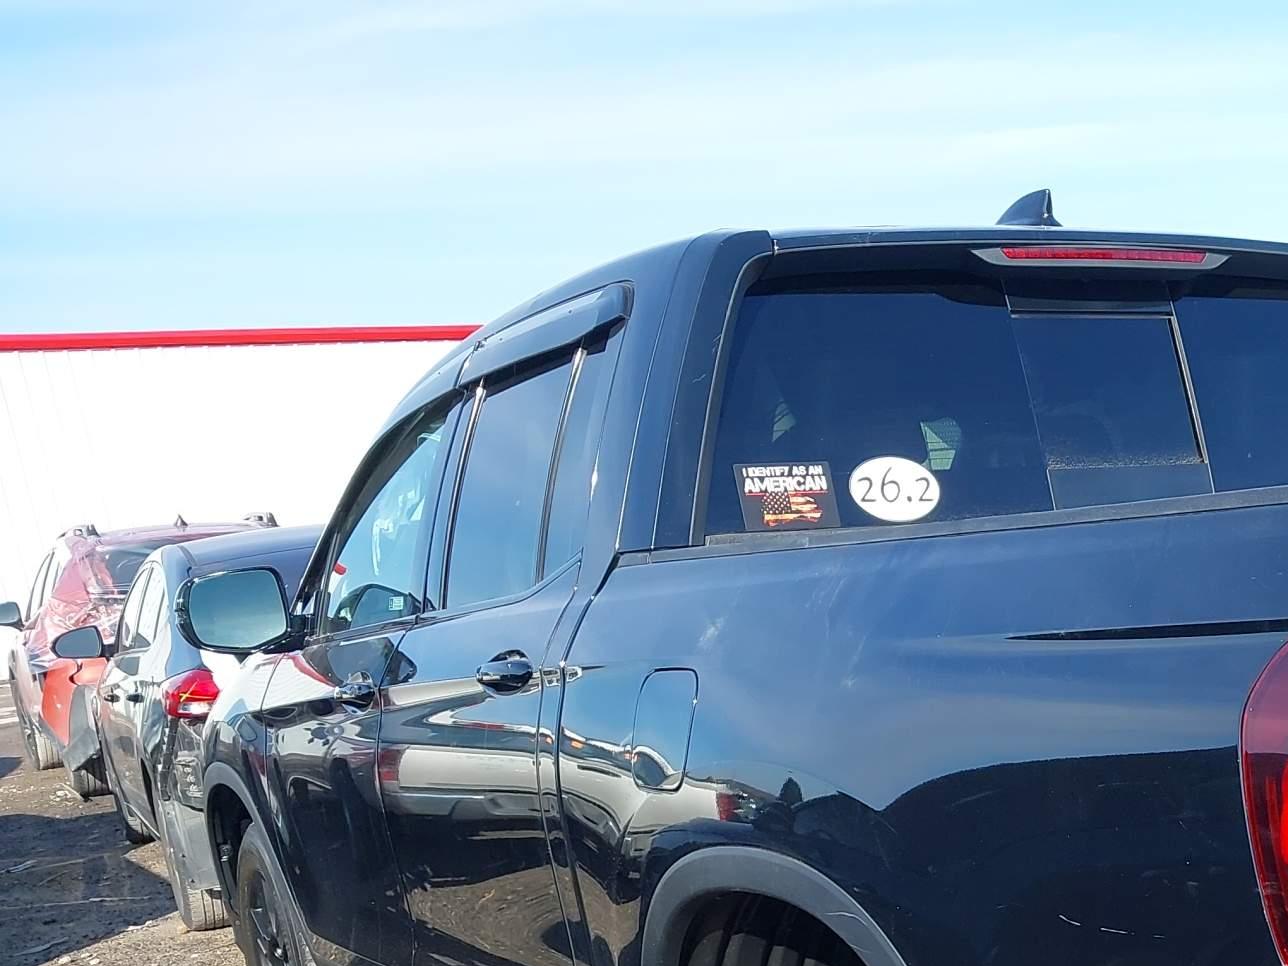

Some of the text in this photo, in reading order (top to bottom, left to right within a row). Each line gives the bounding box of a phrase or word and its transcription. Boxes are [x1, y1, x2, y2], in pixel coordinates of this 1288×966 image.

[748, 465, 790, 477] IDENTIFY
[792, 465, 808, 477] AS
[808, 464, 823, 476] AN
[744, 475, 828, 493] AMERICAN
[857, 466, 934, 503] 26.2
